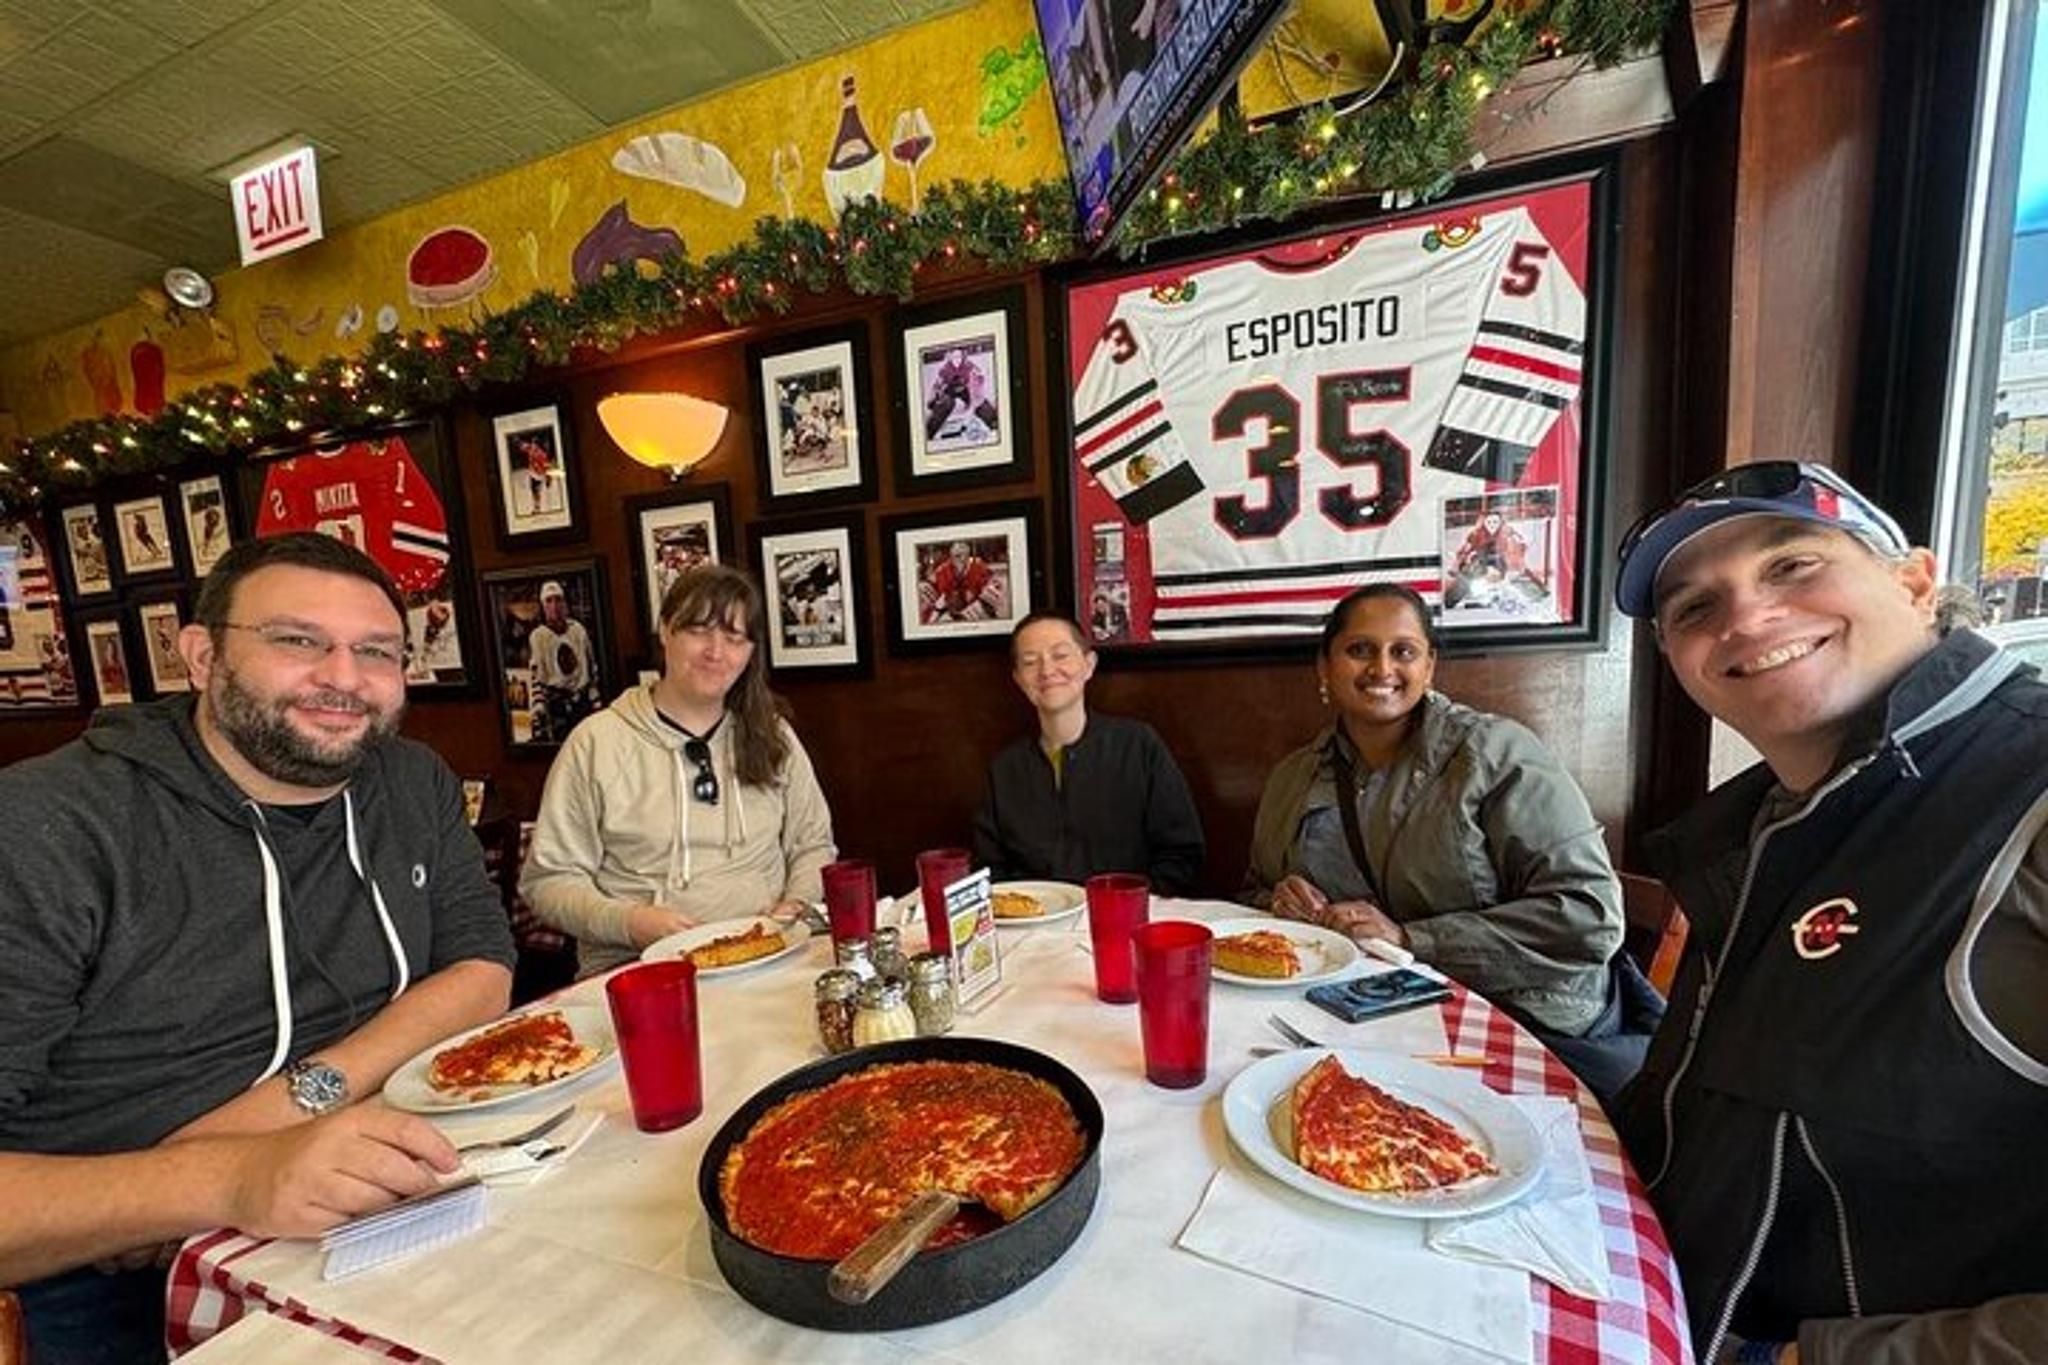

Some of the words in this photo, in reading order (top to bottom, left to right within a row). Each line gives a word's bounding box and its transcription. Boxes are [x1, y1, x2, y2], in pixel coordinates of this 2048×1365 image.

[244, 160, 302, 239] EXIT
[1501, 240, 1550, 296] 5
[1102, 318, 1138, 365] 3
[1226, 295, 1399, 362] ESPOSITO
[1212, 367, 1412, 541] 35
